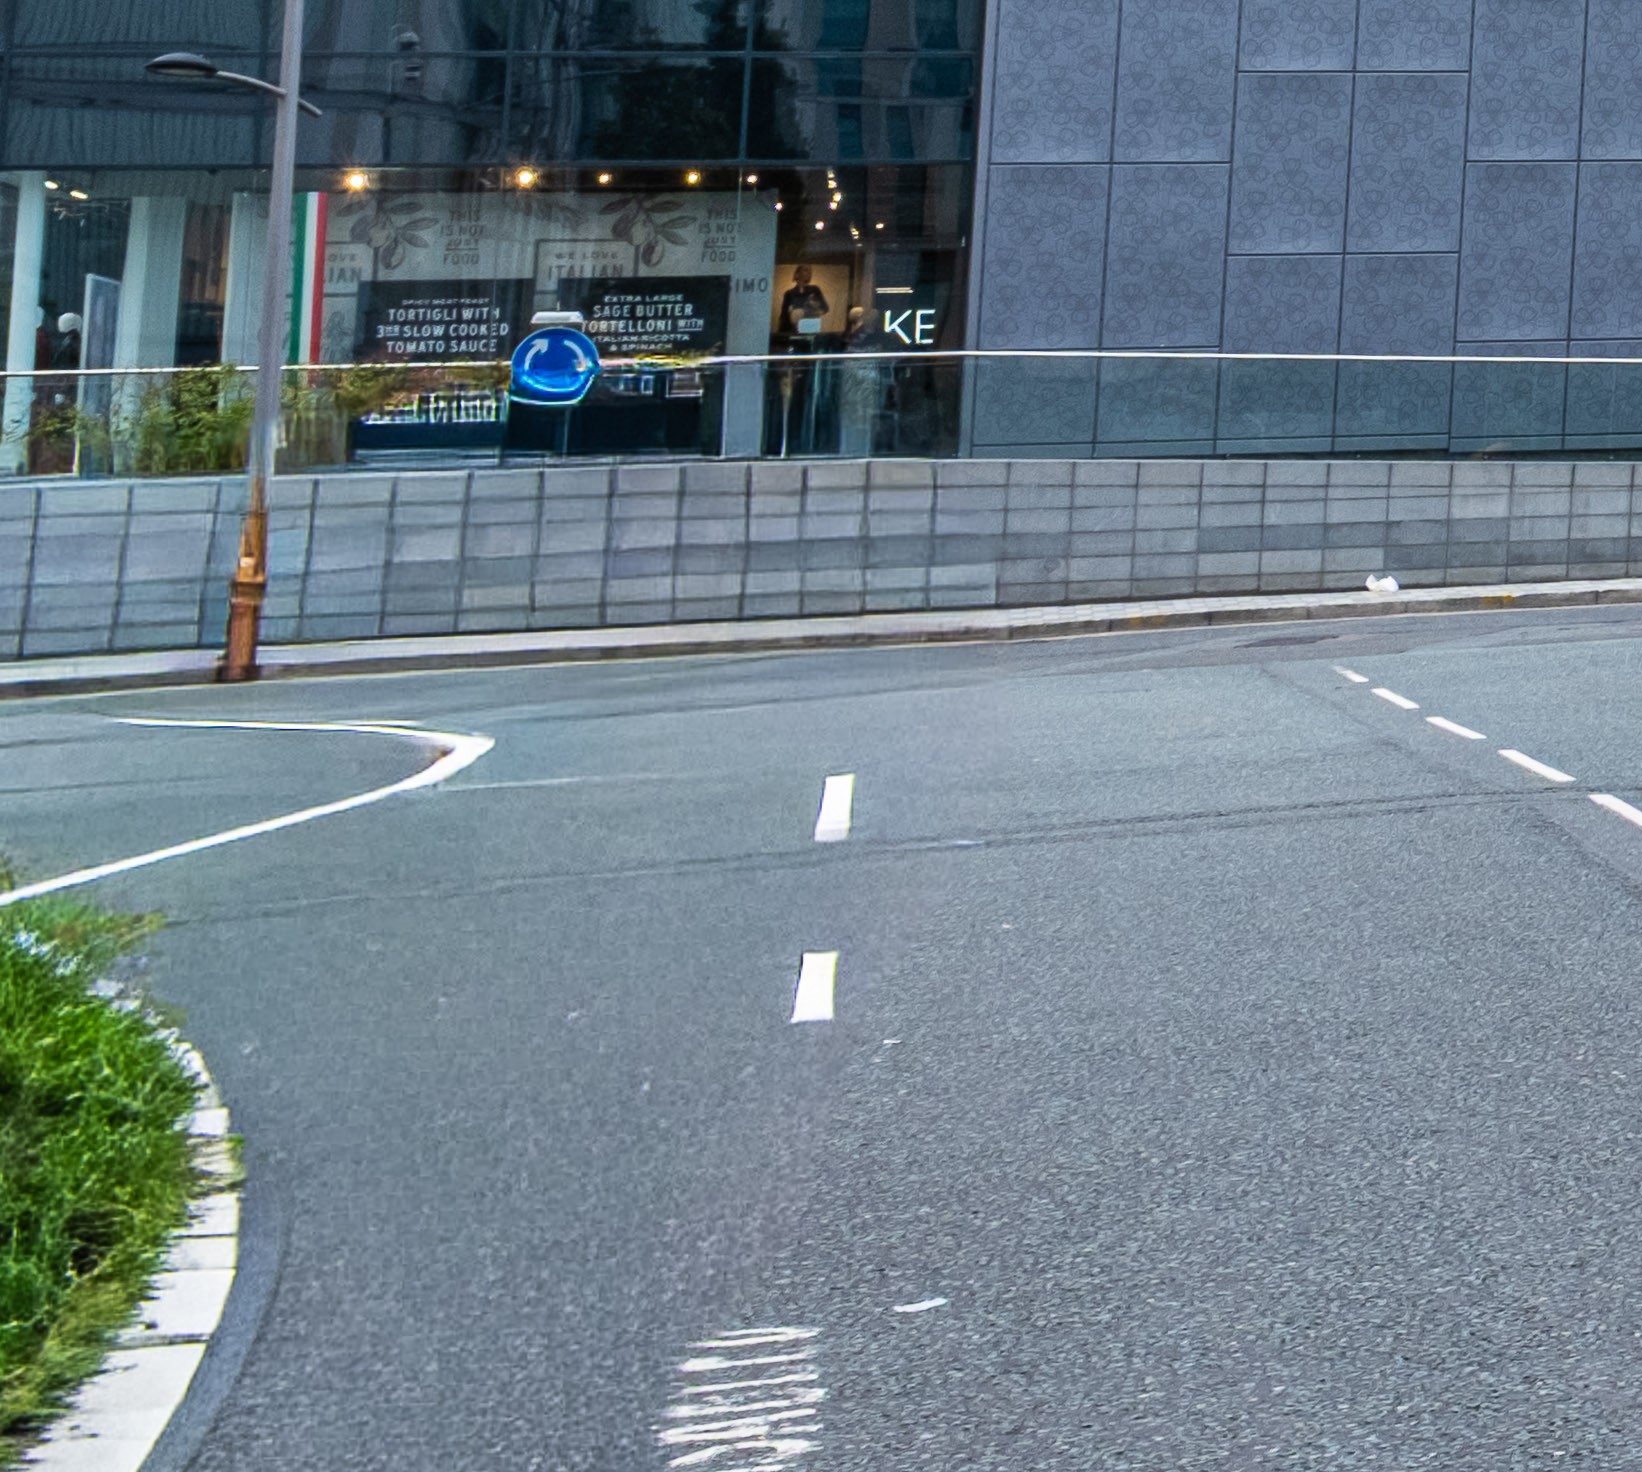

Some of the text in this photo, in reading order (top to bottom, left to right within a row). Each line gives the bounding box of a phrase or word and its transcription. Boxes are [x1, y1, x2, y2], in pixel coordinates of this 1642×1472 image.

[387, 306, 501, 322] TORTIGLI WITH
[592, 303, 693, 318] SAGE BUTTER
[402, 324, 446, 337] SLOW
[449, 322, 510, 336] COOKED
[581, 318, 704, 333] TORTELLONI WITH
[385, 339, 498, 354] TOMATO SAUCE
